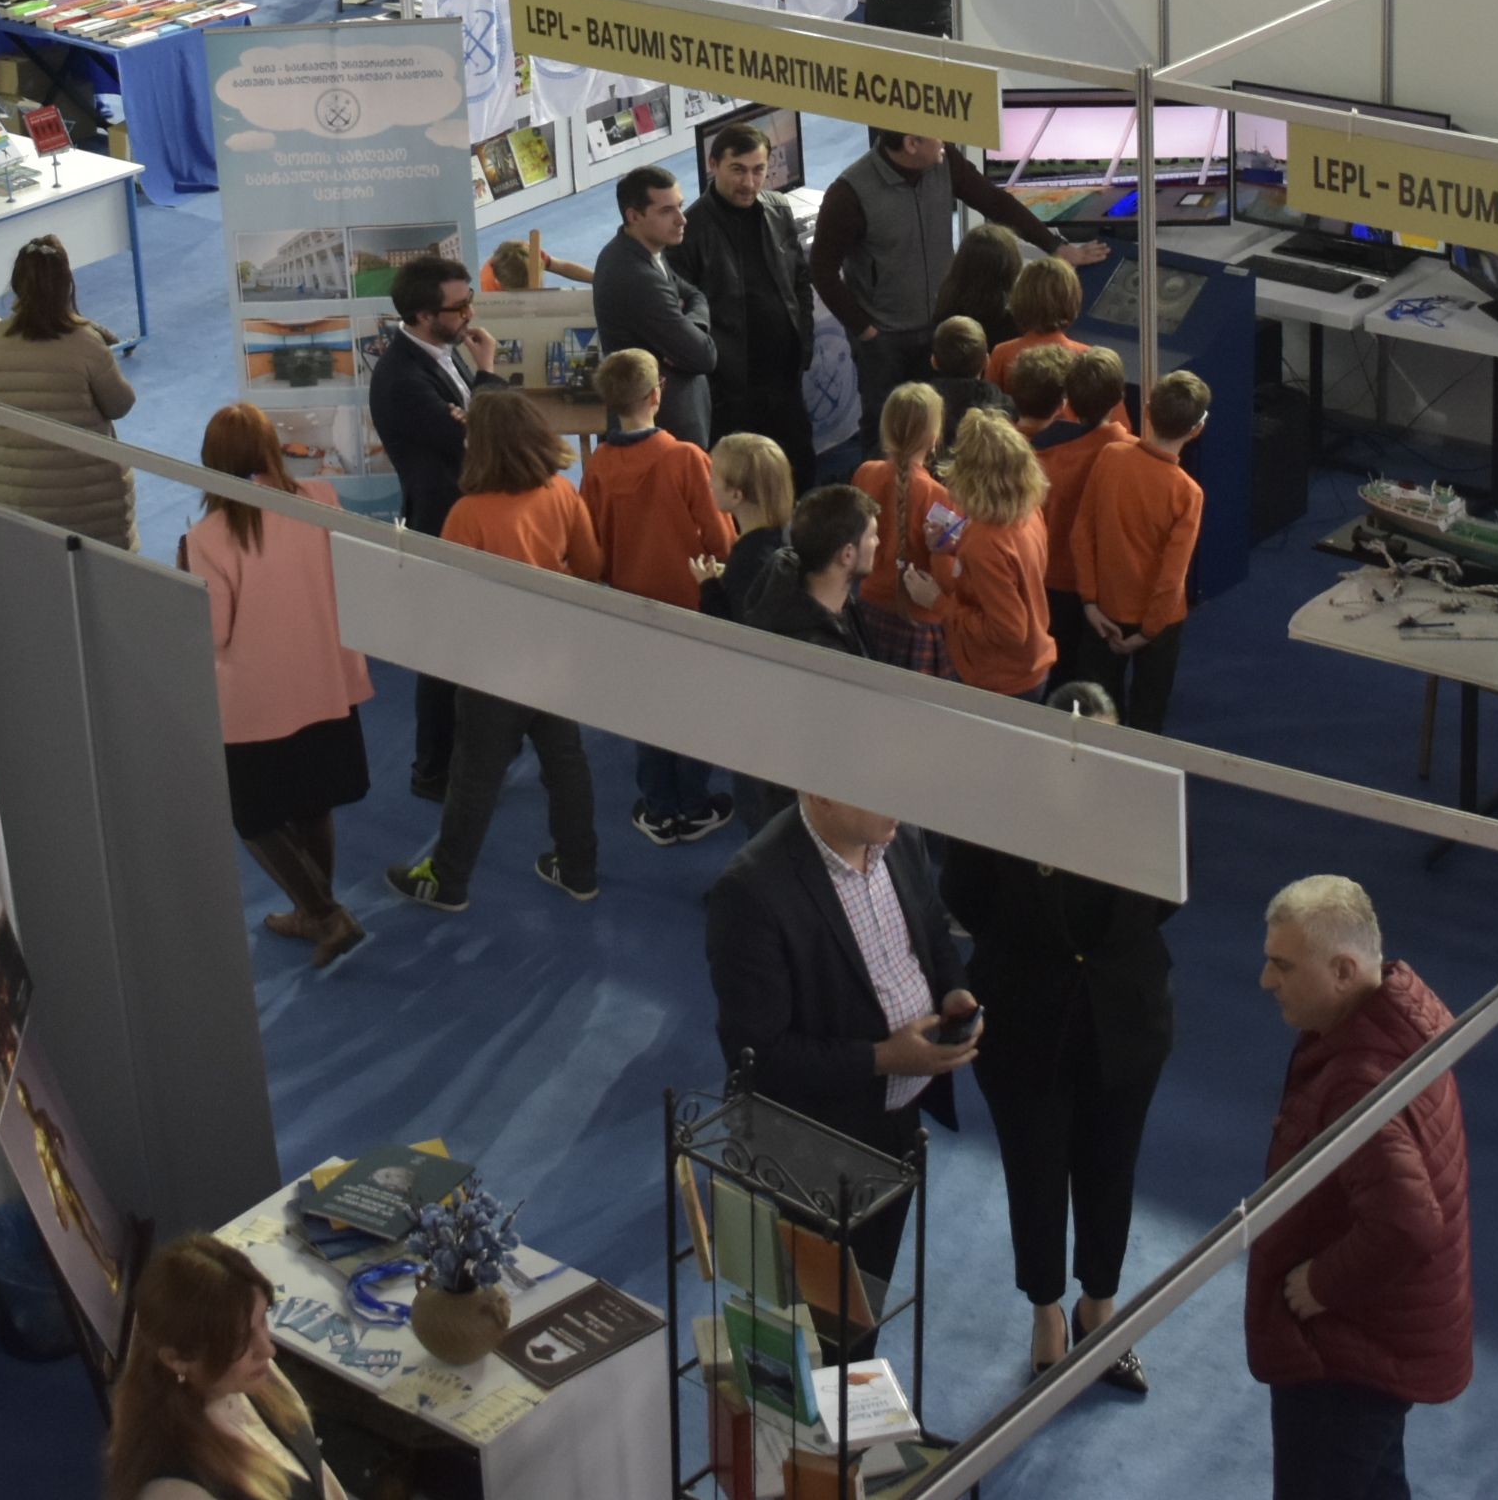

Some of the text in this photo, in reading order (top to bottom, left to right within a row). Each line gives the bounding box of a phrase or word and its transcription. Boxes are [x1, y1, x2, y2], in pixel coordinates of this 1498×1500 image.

[253, 64, 276, 74] სსიპ
[285, 61, 338, 73] სასწავლო
[341, 58, 415, 71] უნივერსიტეტი
[526, 5, 569, 40] LEPL
[586, 18, 665, 60] BATUMI
[670, 36, 735, 75] STATE
[739, 48, 849, 98] MARITIME
[854, 73, 974, 122] ACADEMY
[232, 69, 444, 88] ბათუმის სახელმწიფო საზღვაო აკადემია
[274, 148, 408, 167] ფოთის საზღვაო
[1312, 155, 1371, 197] LEPL
[312, 186, 375, 201] ცენტრი
